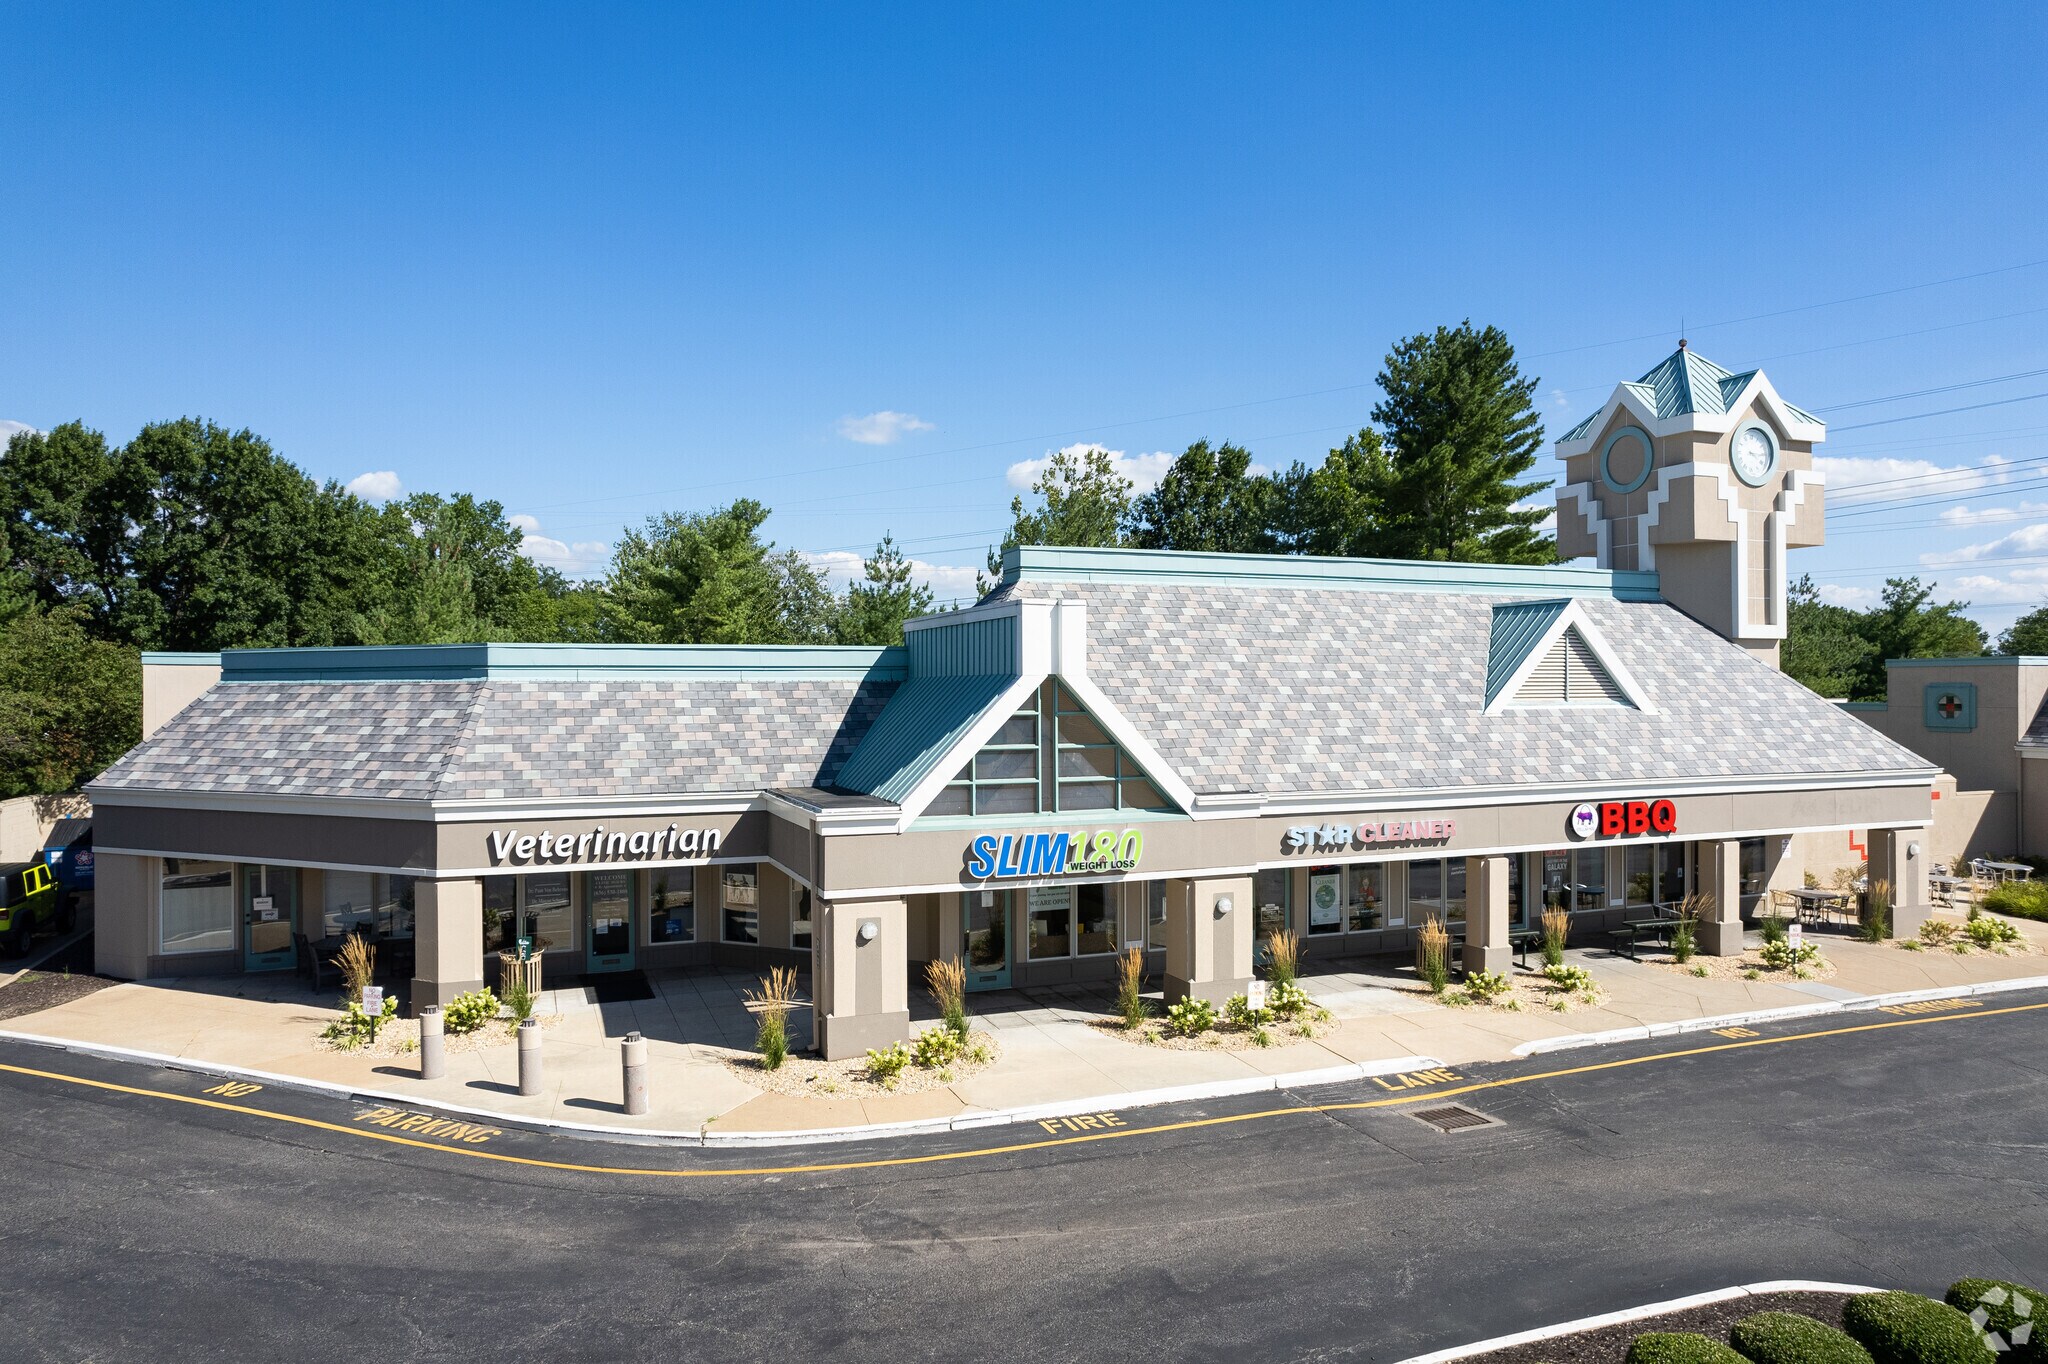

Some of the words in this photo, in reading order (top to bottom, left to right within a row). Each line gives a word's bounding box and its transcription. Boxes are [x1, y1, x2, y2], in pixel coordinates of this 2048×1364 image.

[1601, 799, 1678, 836] BBQ
[492, 822, 722, 860] Veterinarian
[1355, 819, 1457, 843] CLEANER
[1070, 860, 1109, 871] WEIGHT
[1110, 859, 1136, 869] LOSS
[1547, 863, 1568, 871] GALAXY
[1710, 1026, 1761, 1039] NO
[202, 1081, 263, 1098] NO
[1372, 1067, 1465, 1091] LANE
[353, 1107, 503, 1144] PARKING
[1036, 1112, 1128, 1134] FIRE
